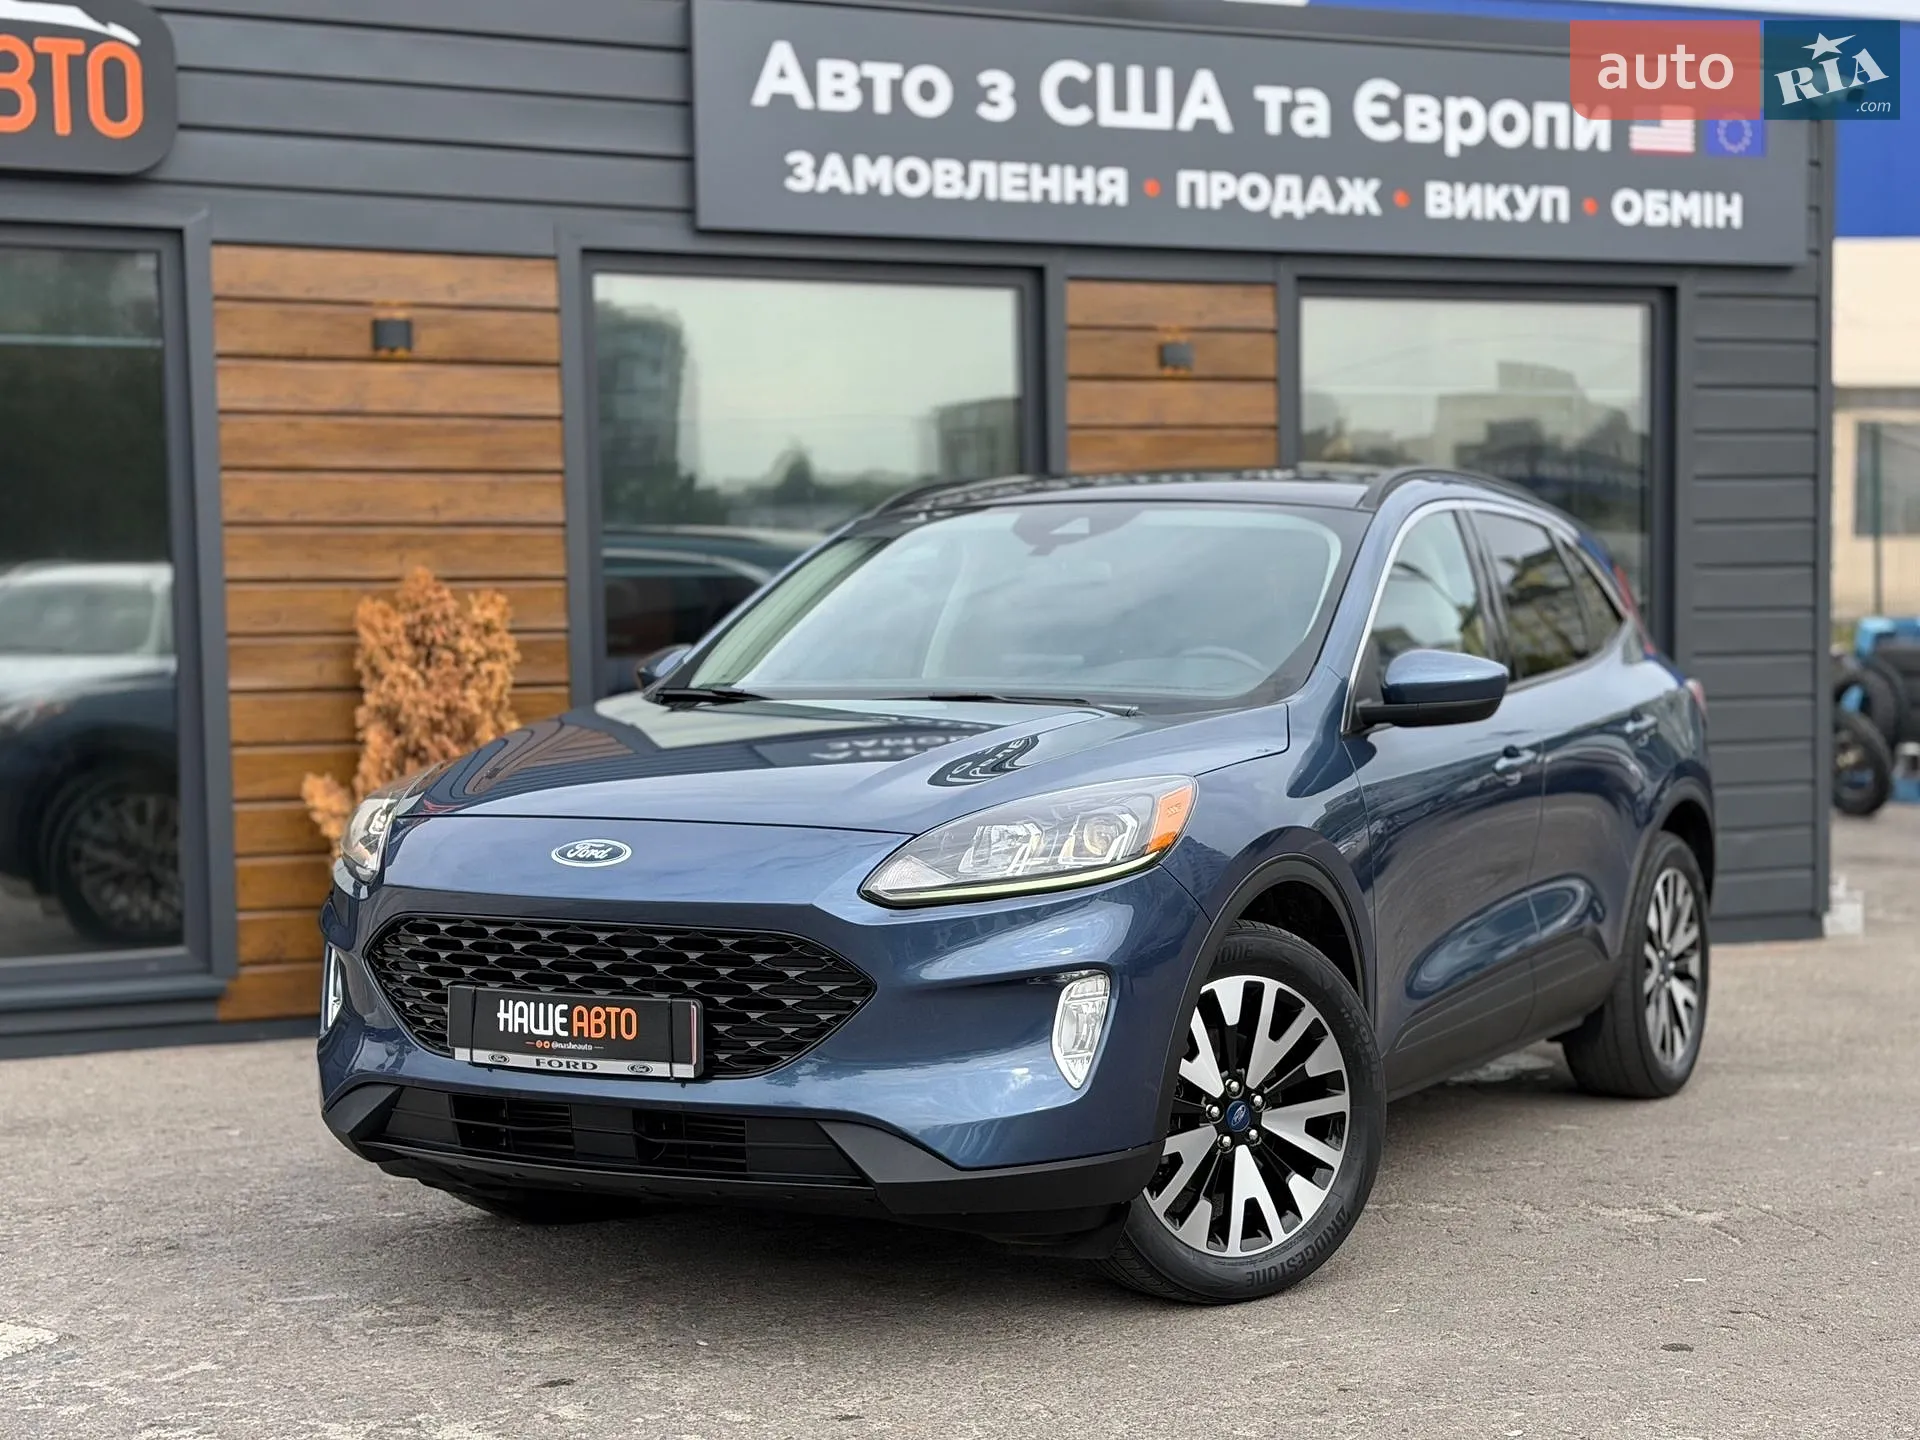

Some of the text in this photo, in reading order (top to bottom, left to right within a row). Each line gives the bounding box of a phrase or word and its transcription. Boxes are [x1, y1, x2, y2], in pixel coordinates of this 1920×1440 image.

[750, 40, 1612, 157] Авто з США та Європи
[784, 150, 1744, 230] ЗАМОВЛЕННЯ ПРОДАЖ ВИКУП ОБМІН
[497, 999, 638, 1041] НАШЕ АВТО
[551, 1041, 593, 1051] @nasheauto
[535, 1058, 598, 1071] FORD
[1245, 1205, 1352, 1288] BRIDGESTONE
